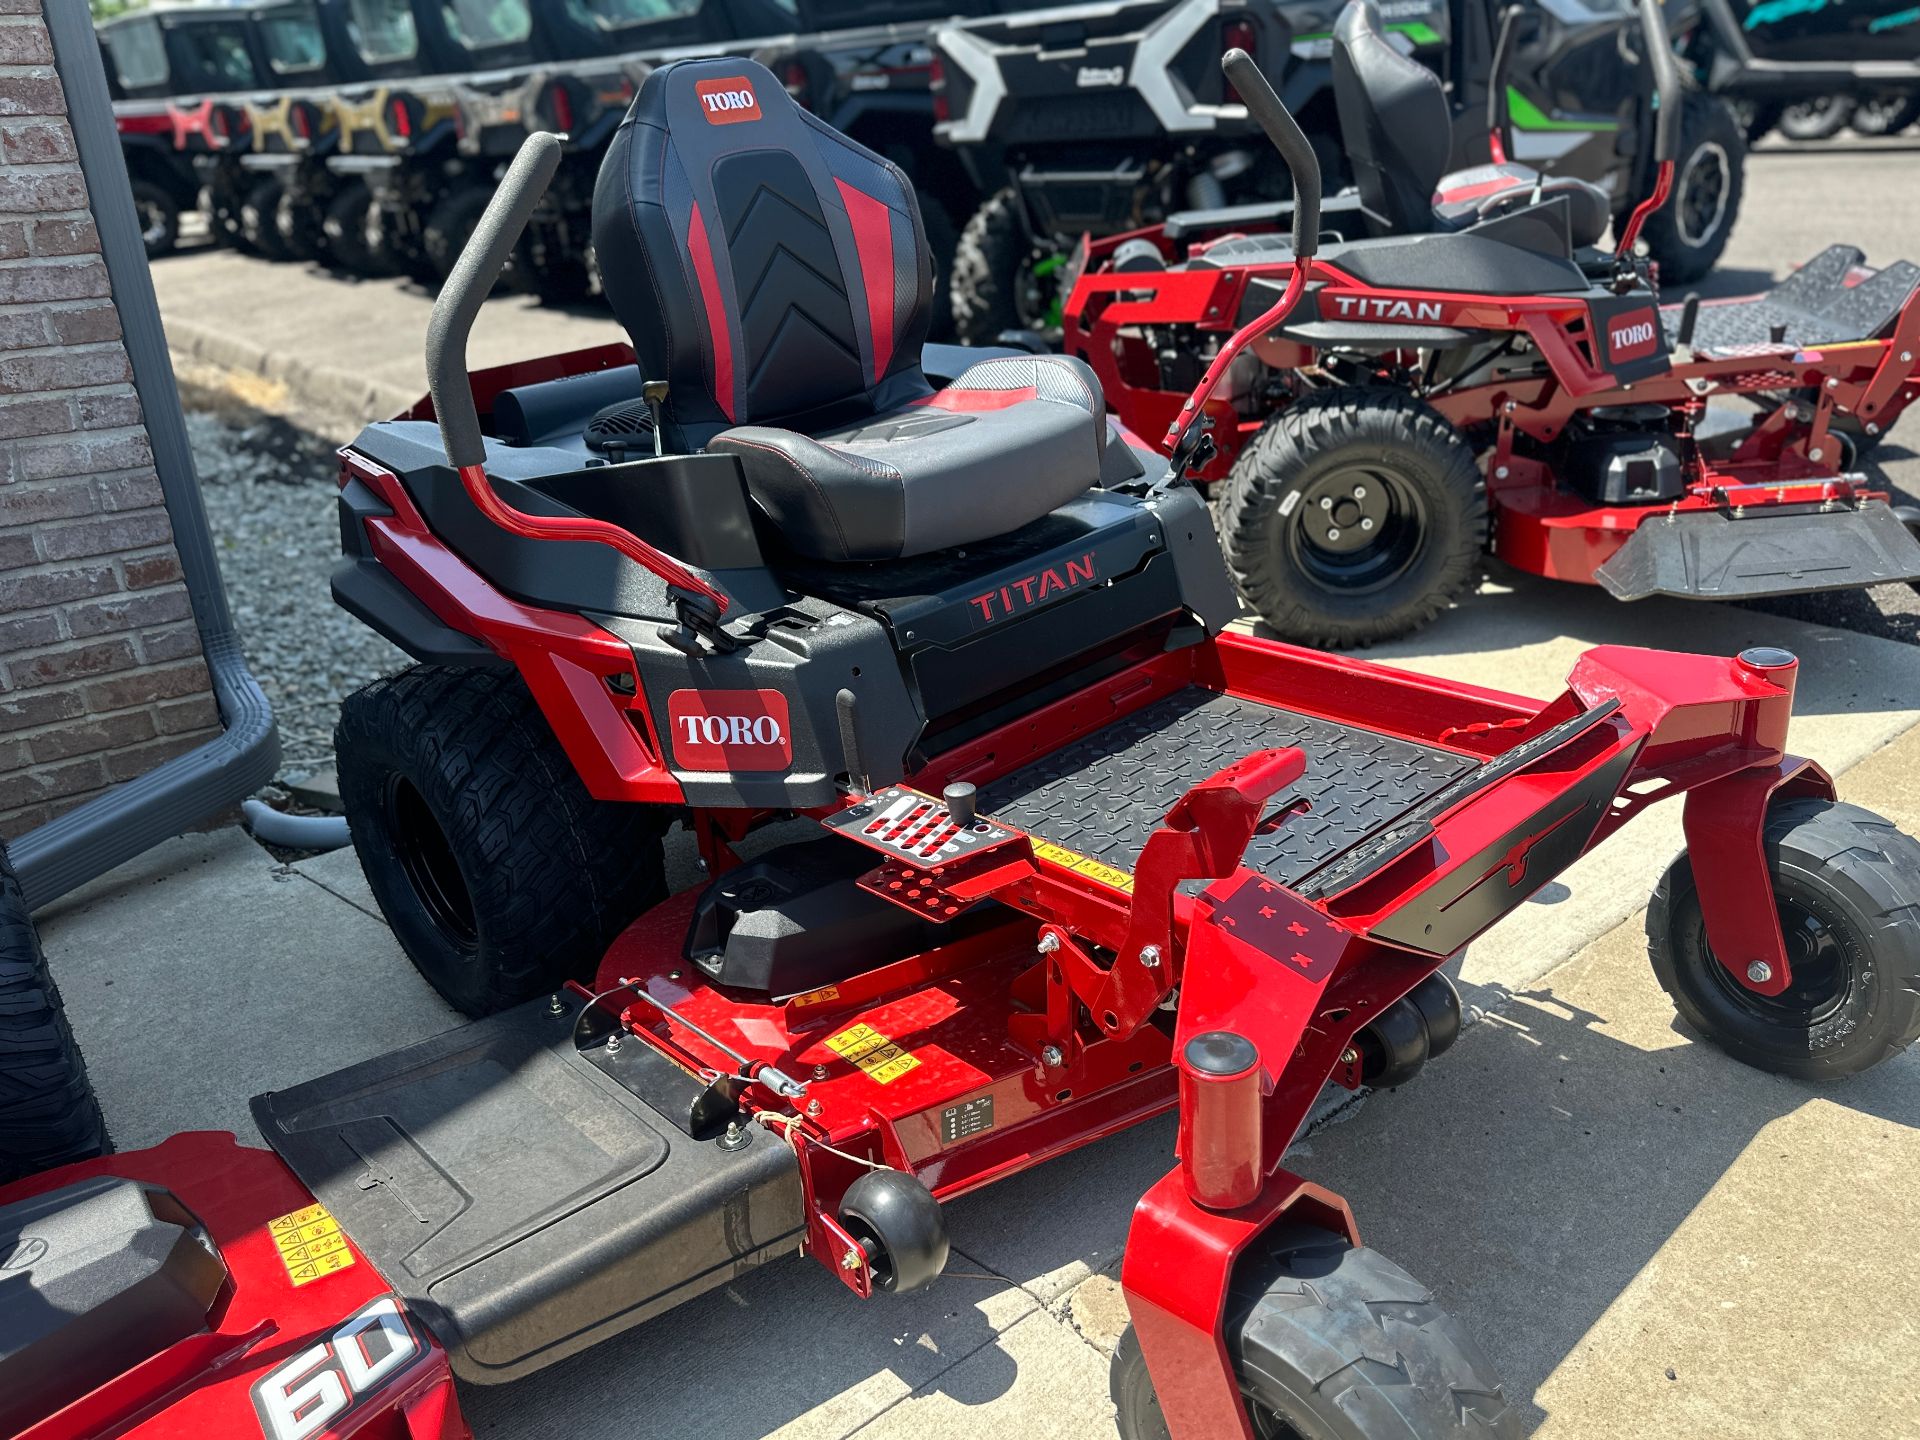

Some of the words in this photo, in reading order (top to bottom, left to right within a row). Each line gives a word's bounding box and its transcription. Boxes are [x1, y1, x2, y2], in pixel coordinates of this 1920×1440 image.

[702, 90, 754, 112] TORO
[1335, 297, 1442, 321] TITAN
[1611, 322, 1653, 350] TORO
[969, 554, 1096, 622] TITAN
[259, 1298, 417, 1440] 60
